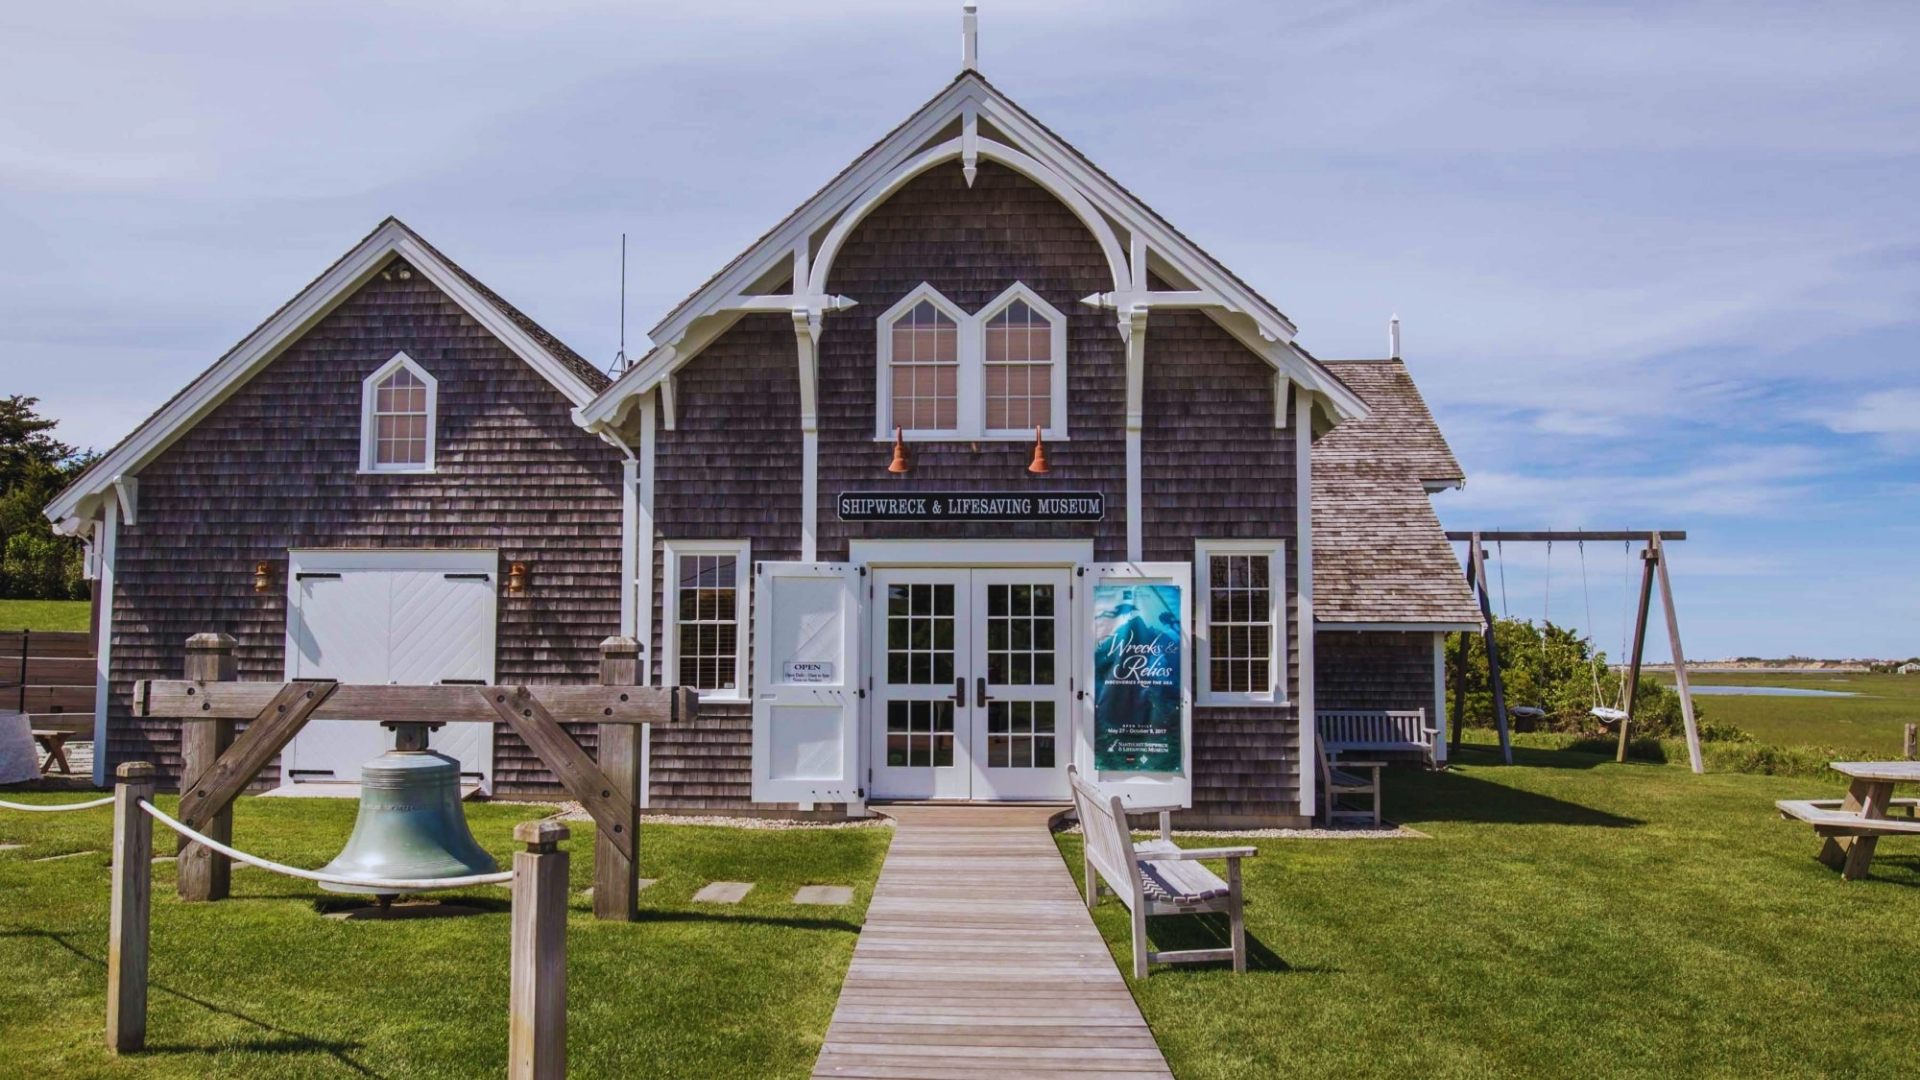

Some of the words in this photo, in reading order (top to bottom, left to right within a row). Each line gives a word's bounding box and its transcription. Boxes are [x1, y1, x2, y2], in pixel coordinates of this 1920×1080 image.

[842, 499, 926, 514] SHIPWRECK
[932, 500, 942, 514] &
[948, 499, 1031, 514] LIFESAVING
[1038, 499, 1100, 514] MUSEUM
[1107, 630, 1162, 656] Wrecks
[1113, 654, 1173, 688] Relics
